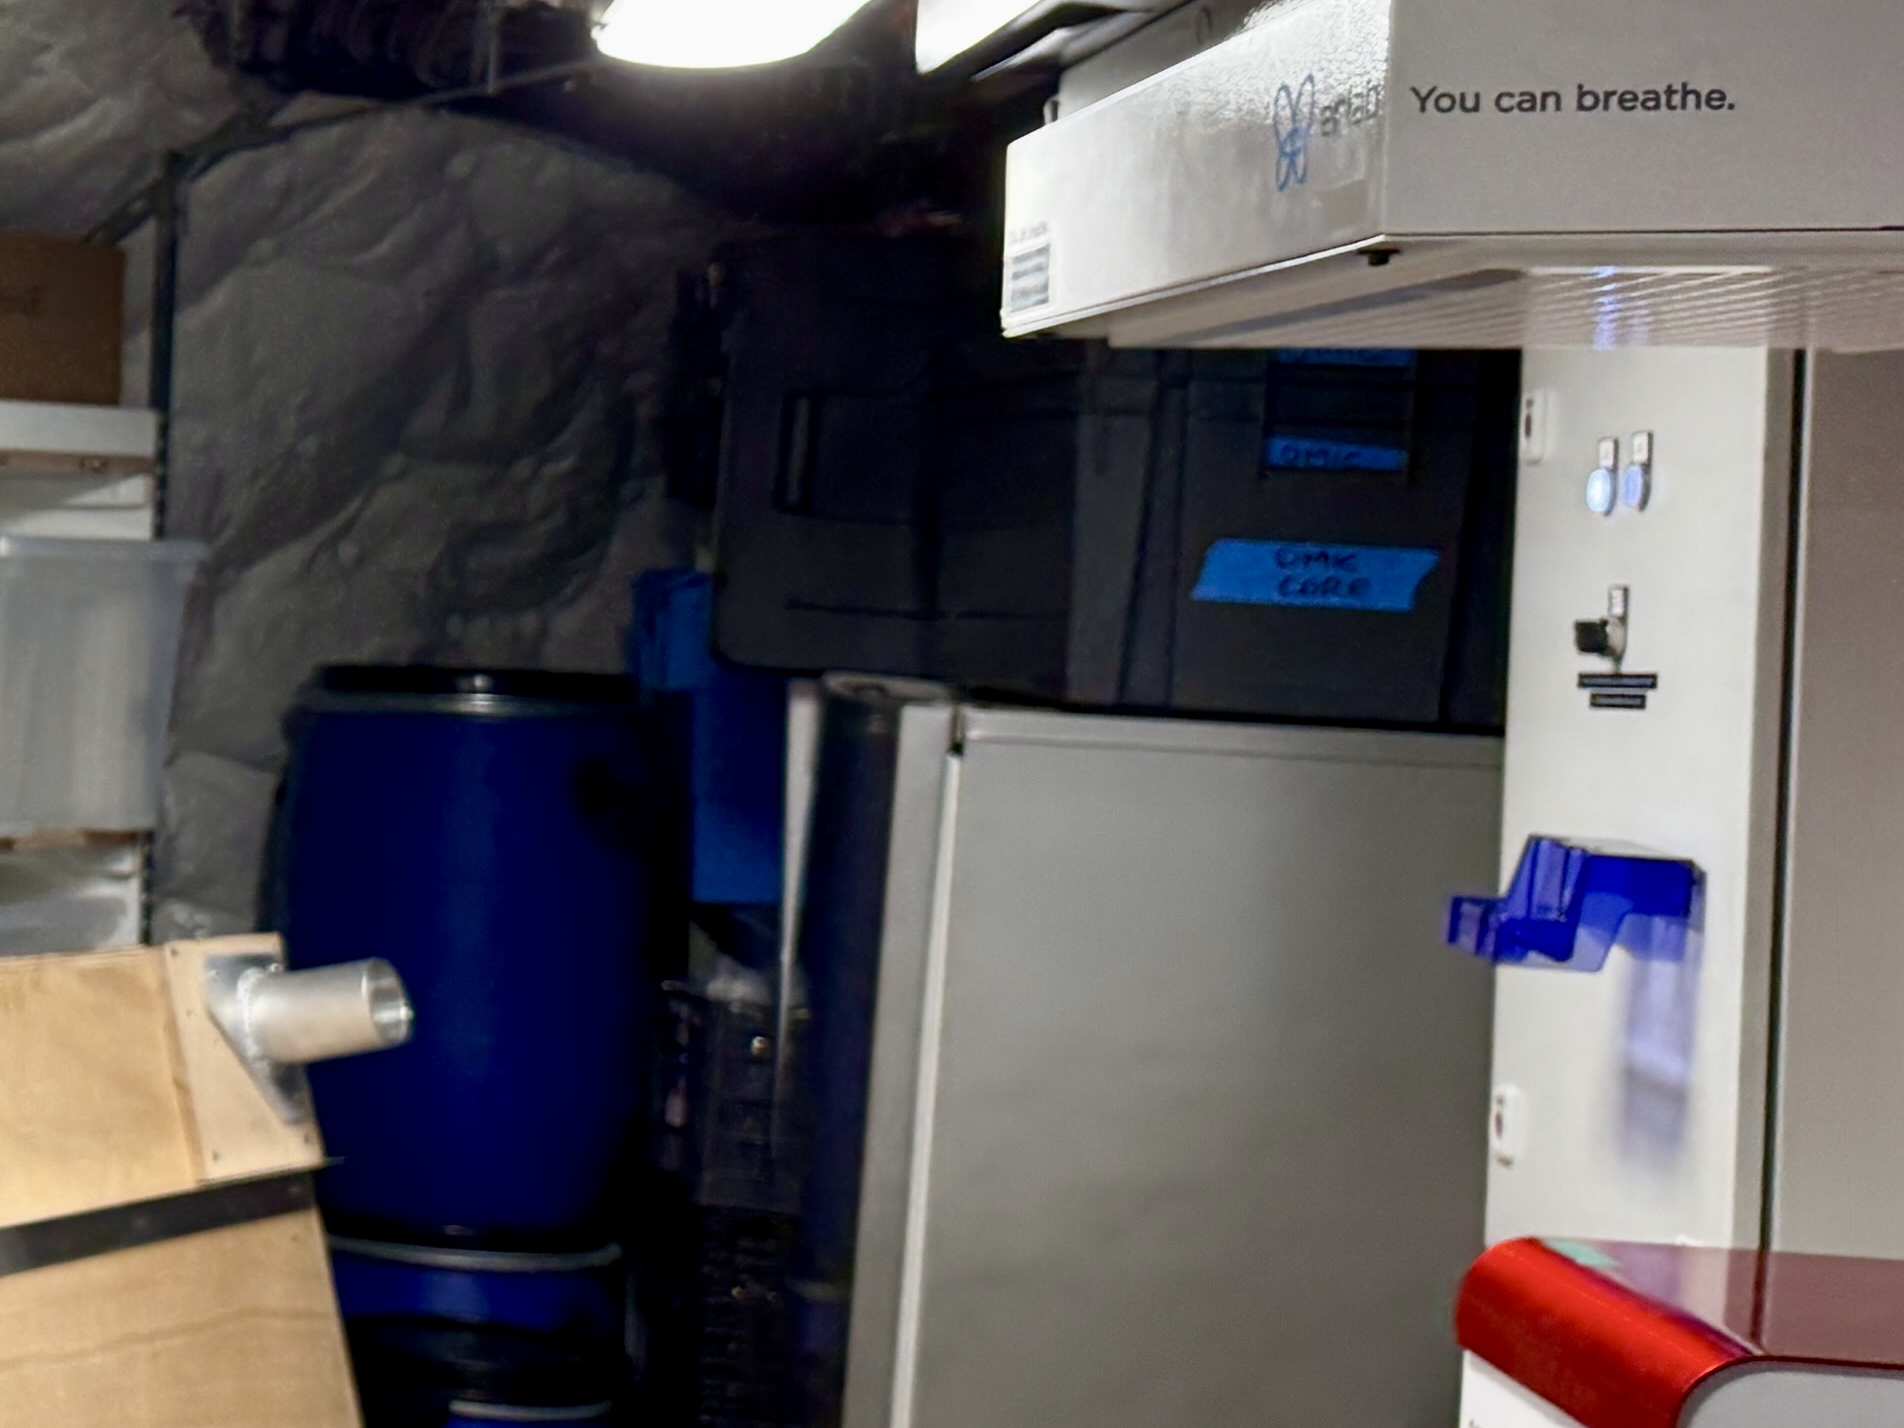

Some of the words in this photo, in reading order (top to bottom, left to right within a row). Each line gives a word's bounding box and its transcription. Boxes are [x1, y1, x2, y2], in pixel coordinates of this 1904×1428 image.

[1409, 85, 1481, 114] You
[1494, 89, 1563, 114] can
[1575, 80, 1737, 113] breathe.
